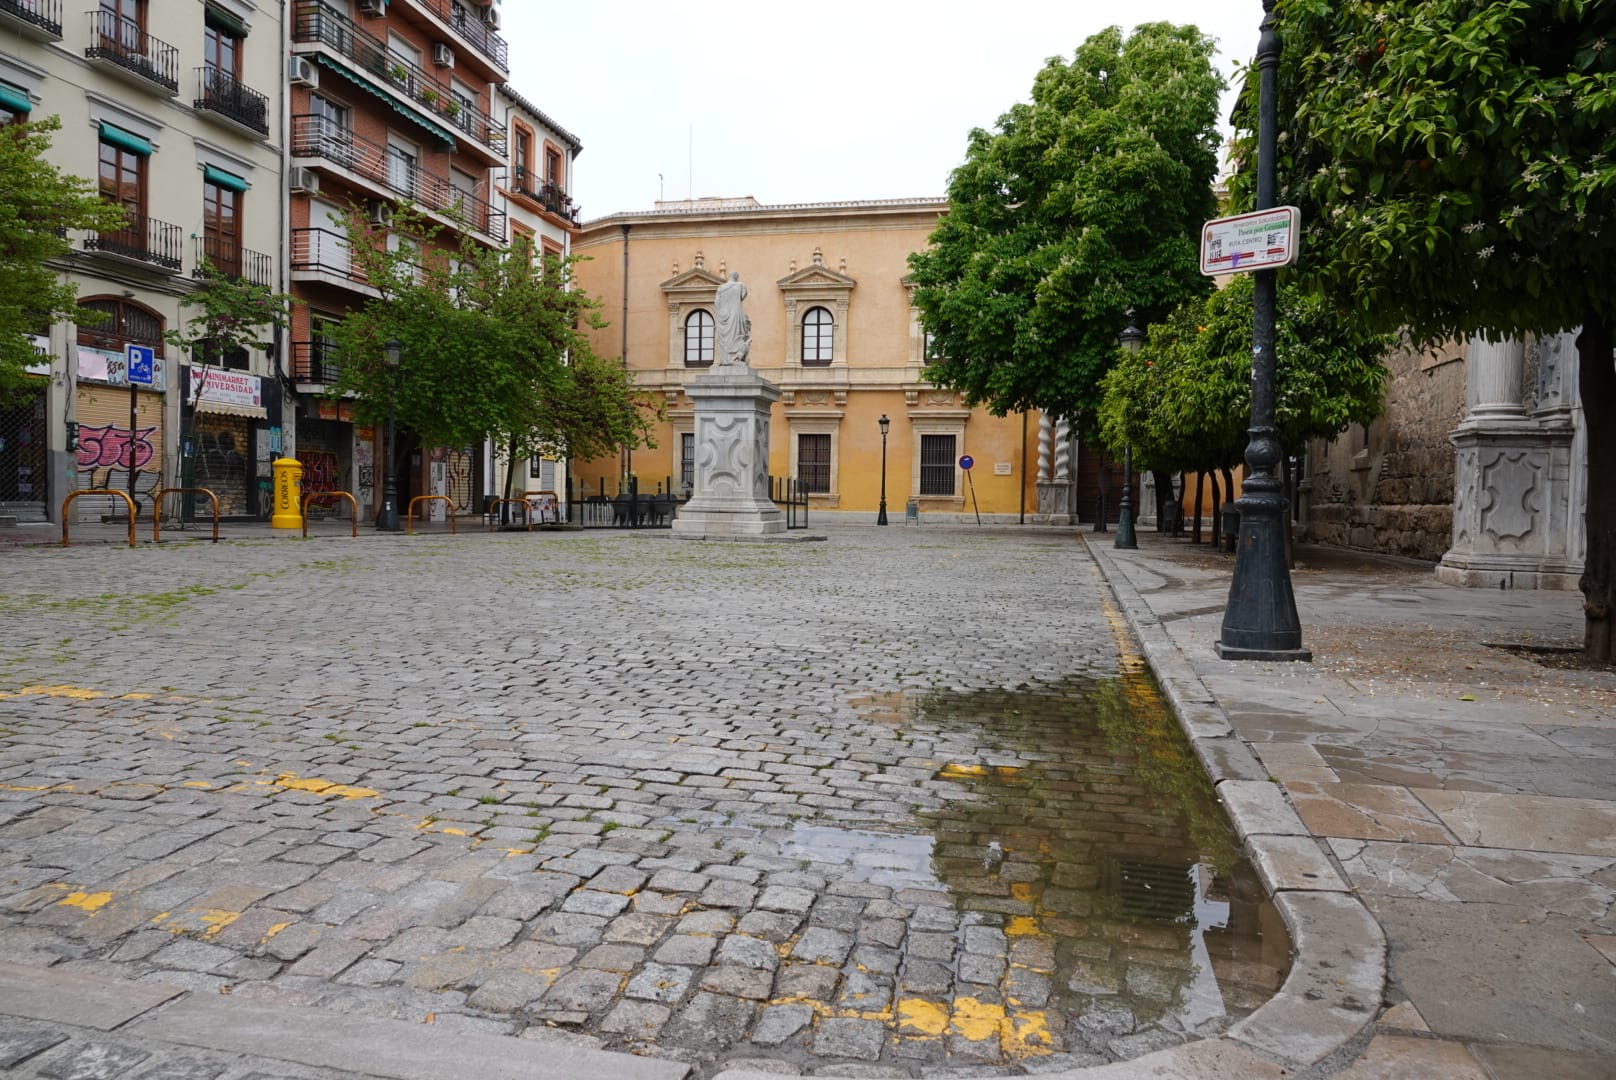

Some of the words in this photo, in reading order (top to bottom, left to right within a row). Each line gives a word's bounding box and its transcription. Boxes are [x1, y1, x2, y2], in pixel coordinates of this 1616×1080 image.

[1241, 236, 1263, 245] CENTRO
[130, 349, 142, 369] P
[280, 470, 289, 509] CORREOS
